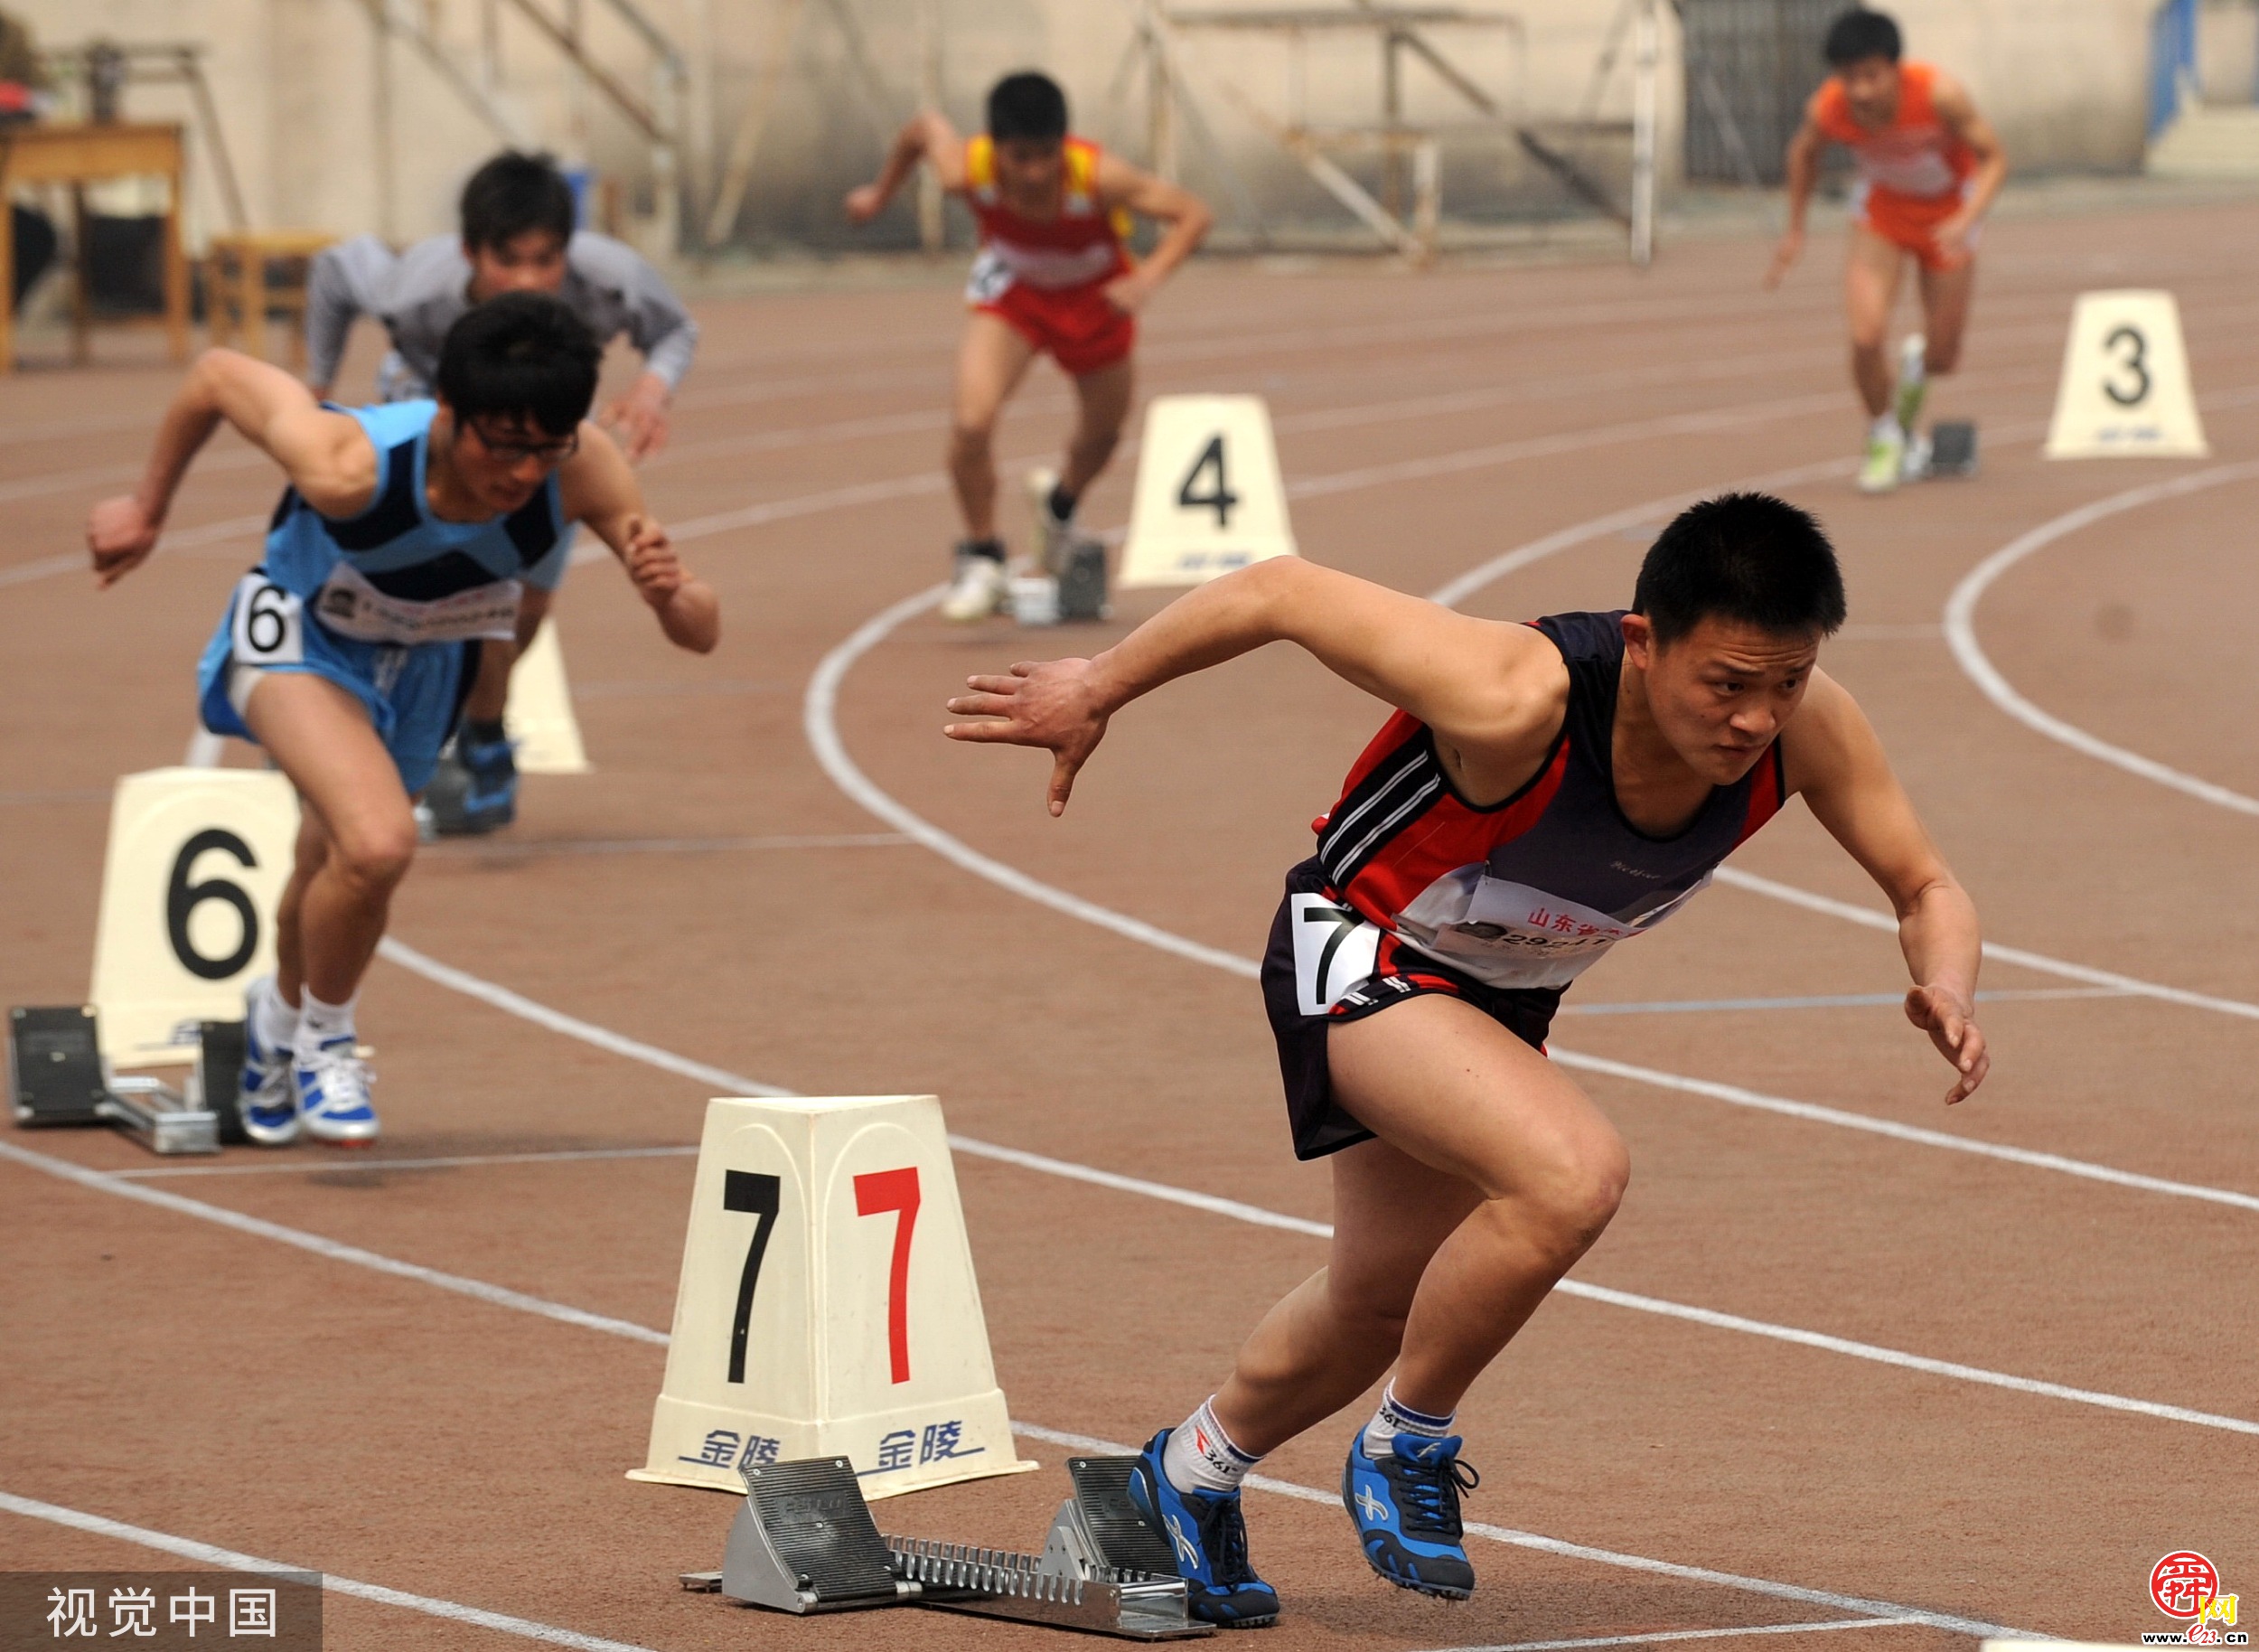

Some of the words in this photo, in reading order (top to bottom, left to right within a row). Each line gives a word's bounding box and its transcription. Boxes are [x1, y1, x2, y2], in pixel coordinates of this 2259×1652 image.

[2104, 326, 2150, 407] 3
[1178, 436, 1239, 528] 4
[248, 583, 287, 653] 6
[166, 828, 258, 981] 6
[1303, 906, 1363, 1006] 7
[723, 1169, 782, 1384] 7
[852, 1166, 922, 1385] 7
[700, 1429, 781, 1471] 金陵
[877, 1420, 962, 1469] 金陵
